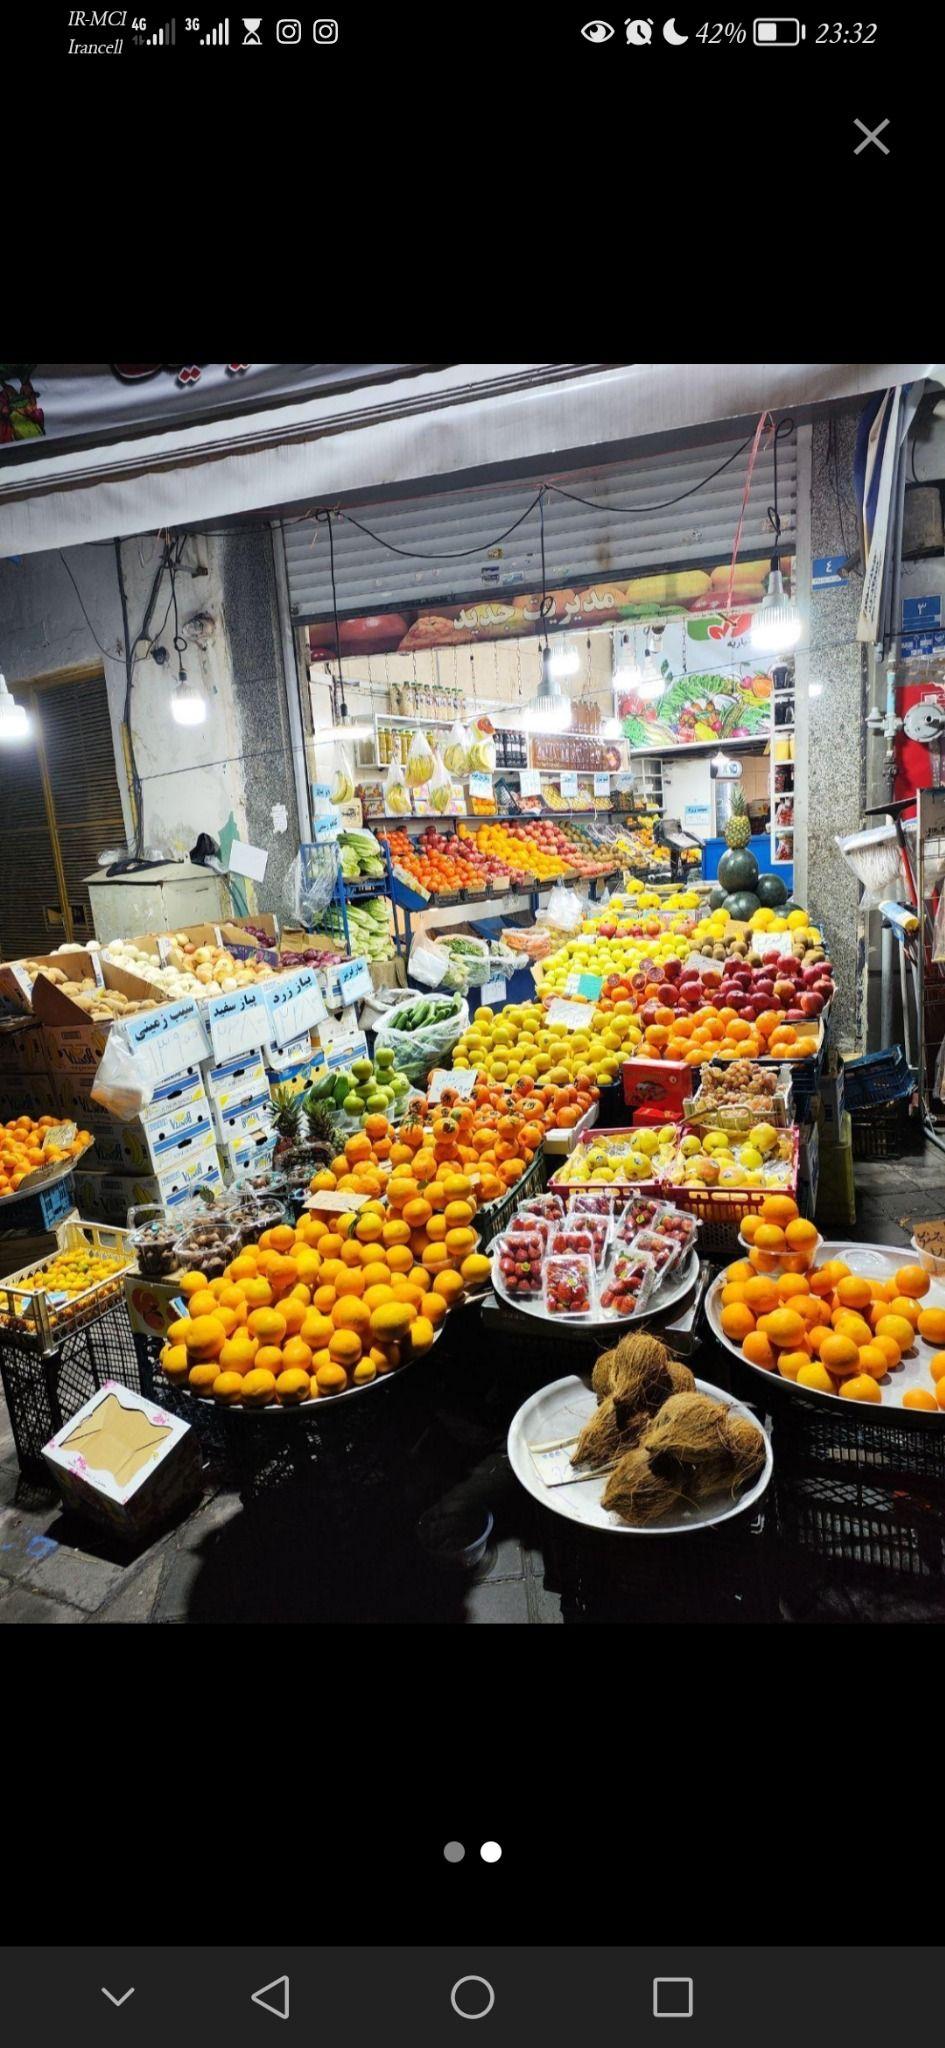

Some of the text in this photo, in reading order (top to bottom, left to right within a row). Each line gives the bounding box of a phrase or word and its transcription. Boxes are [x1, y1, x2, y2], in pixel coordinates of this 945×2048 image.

[453, 591, 615, 635] مدیریت جدید
[213, 994, 257, 1018] پیاز سفید
[272, 975, 312, 1004] پیاز زرد
[135, 1004, 194, 1041] سیب زمینی
